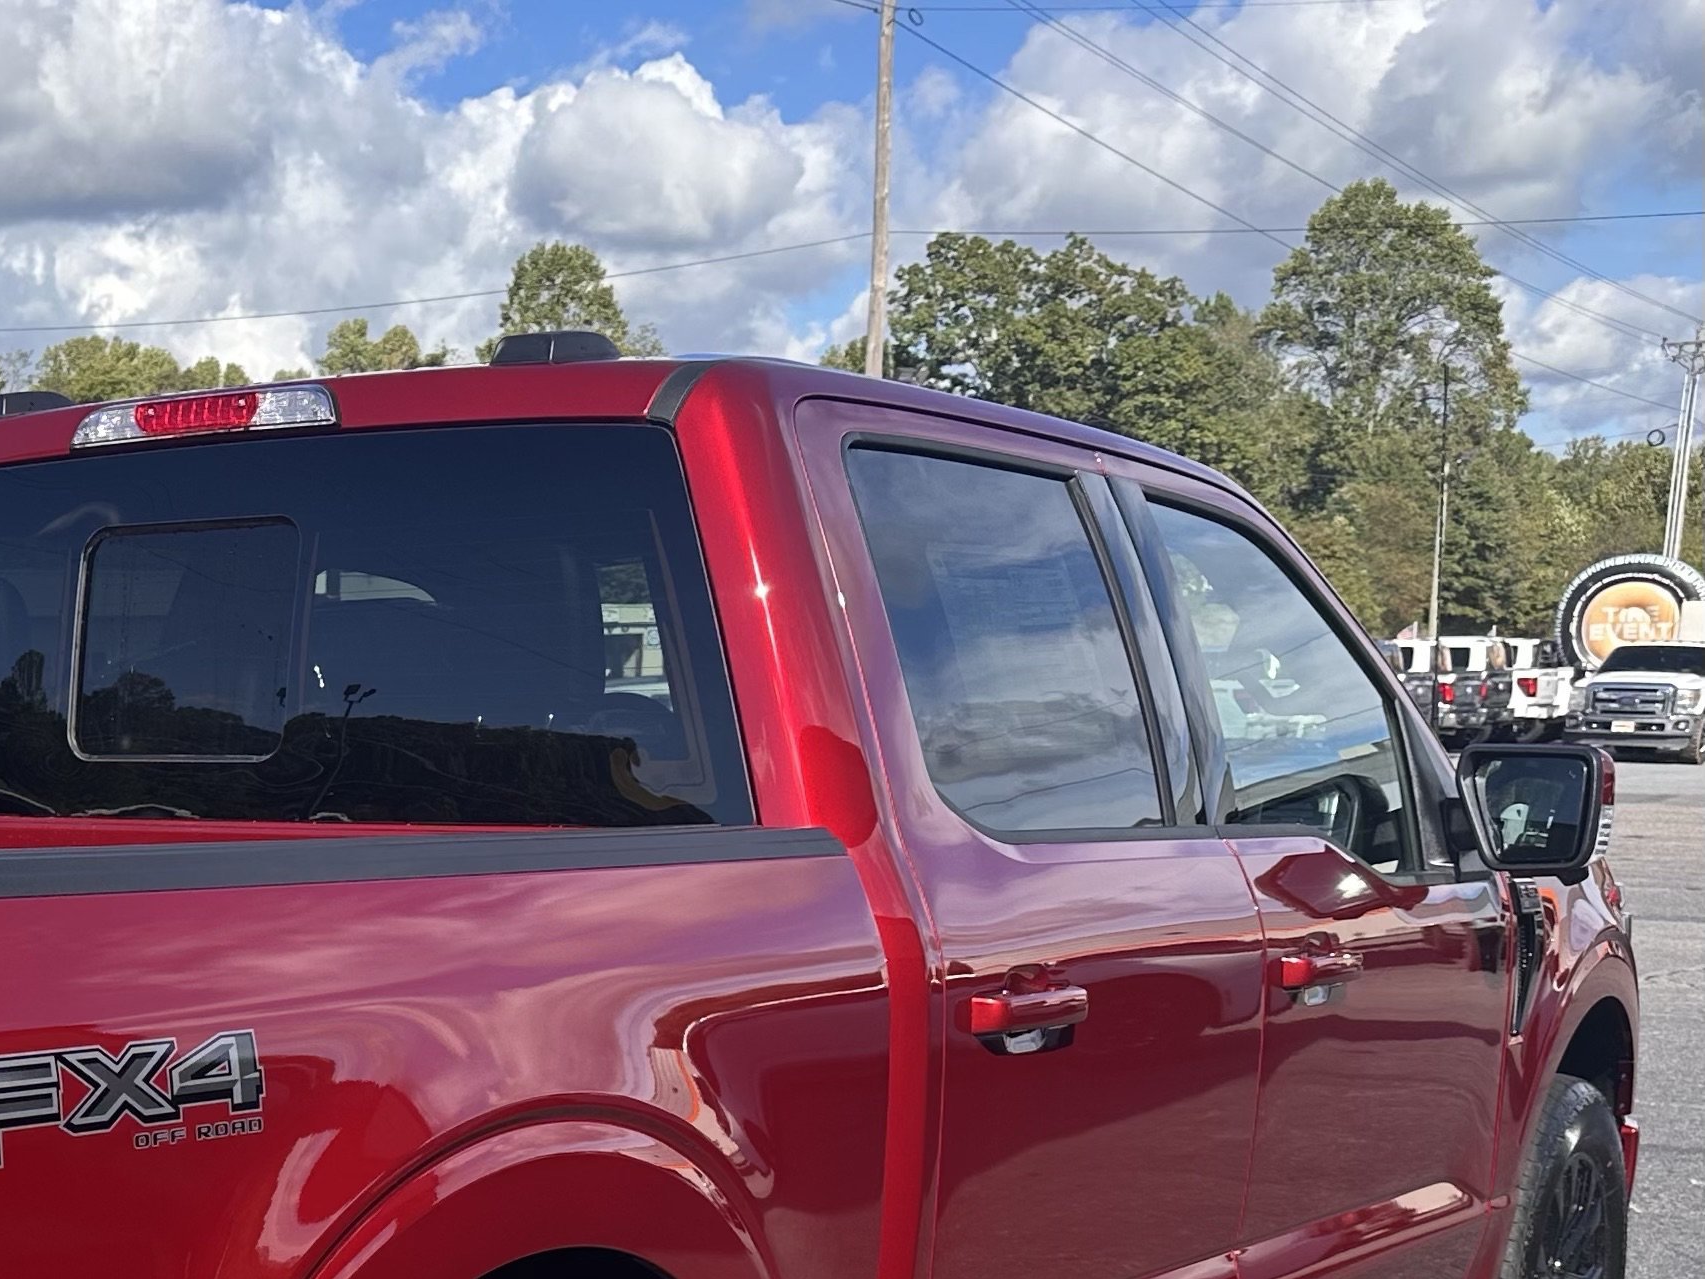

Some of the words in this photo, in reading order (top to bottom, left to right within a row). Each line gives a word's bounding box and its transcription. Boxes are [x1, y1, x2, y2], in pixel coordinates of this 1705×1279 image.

[1589, 622, 1674, 641] EVENT
[134, 1127, 186, 1150] OFF
[197, 1117, 263, 1141] ROAD
